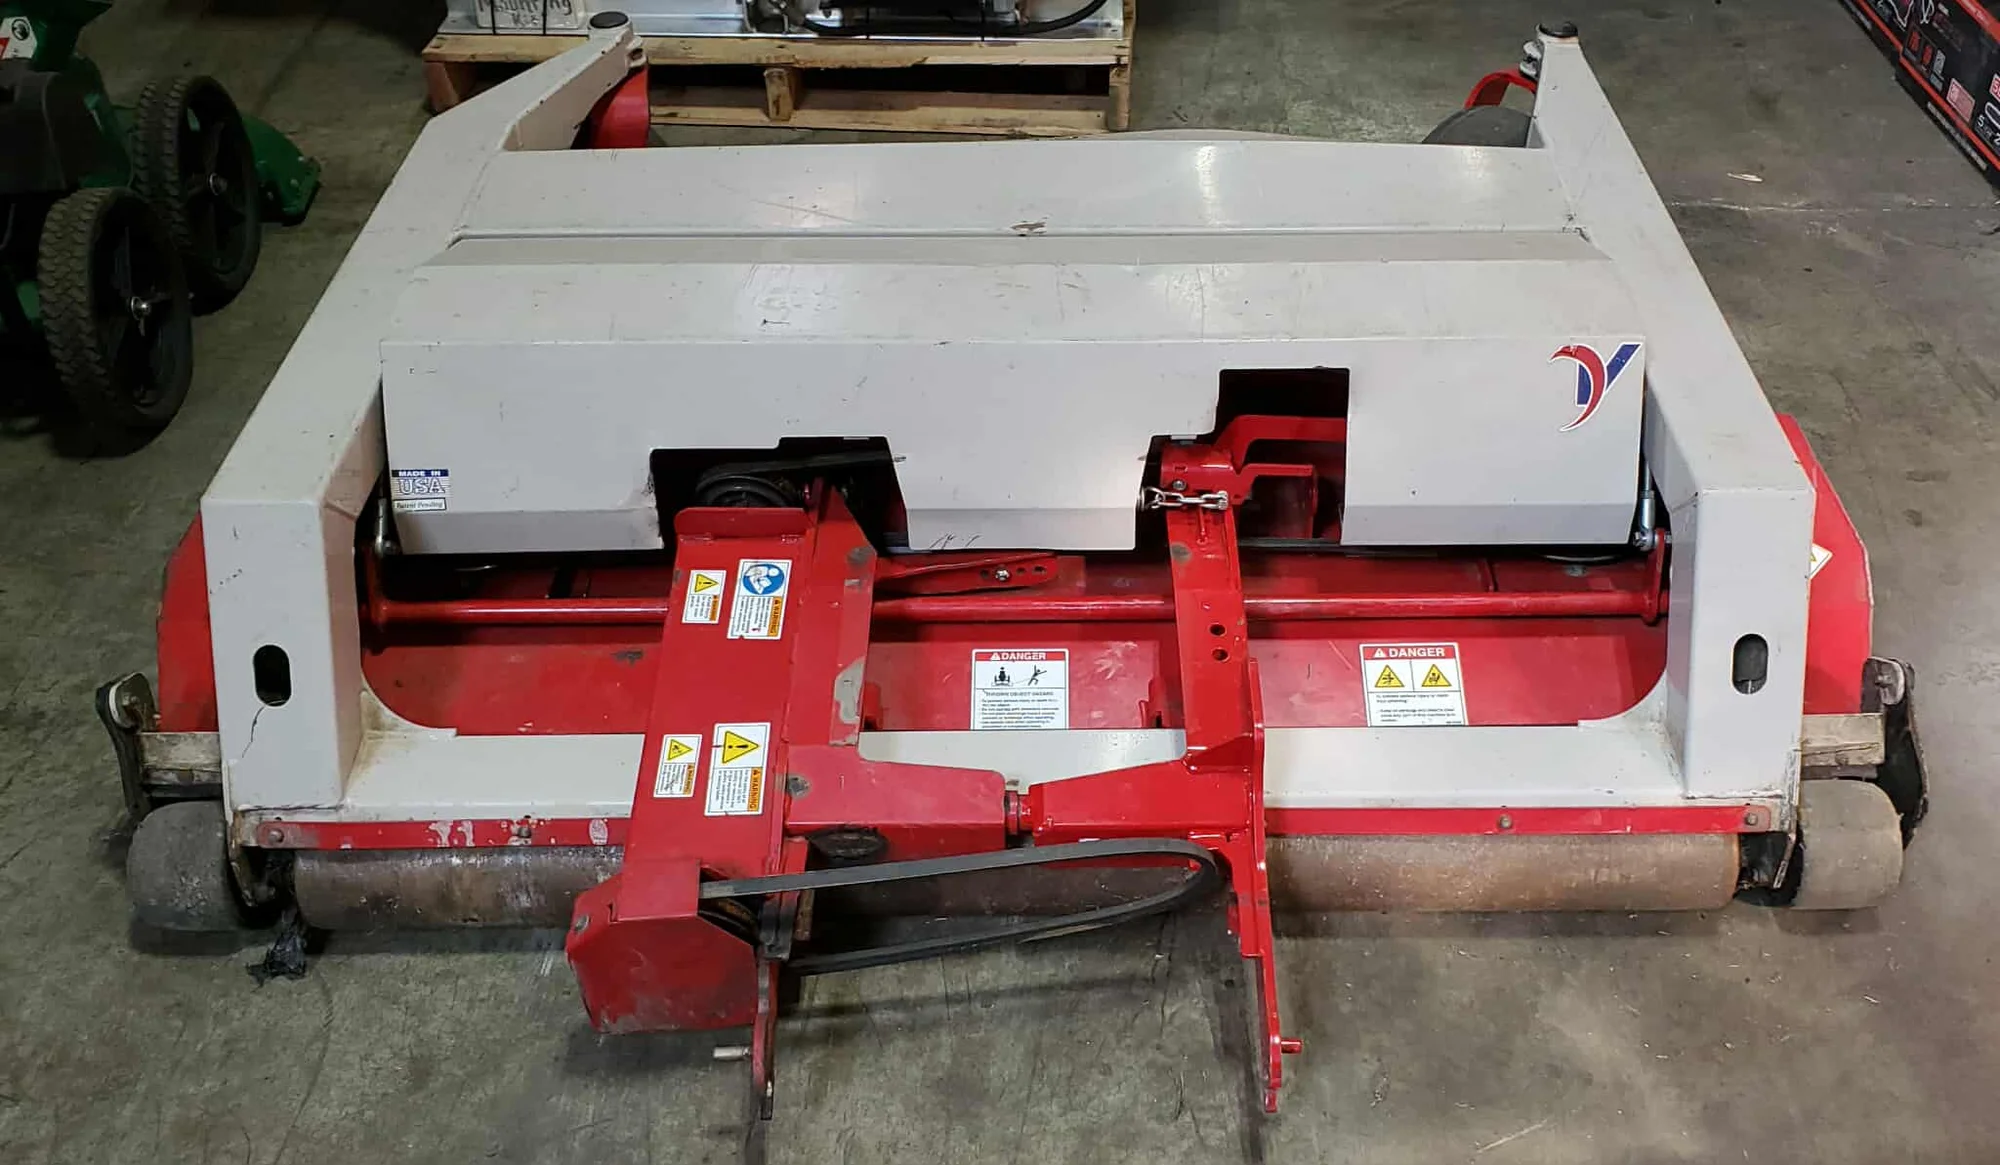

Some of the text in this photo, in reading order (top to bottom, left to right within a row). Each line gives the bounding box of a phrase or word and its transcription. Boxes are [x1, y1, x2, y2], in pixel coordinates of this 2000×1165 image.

[399, 477, 446, 495] USA
[1001, 652, 1047, 660] DANGER
[1389, 647, 1445, 658] DANGER
[749, 777, 760, 809] WARNING
